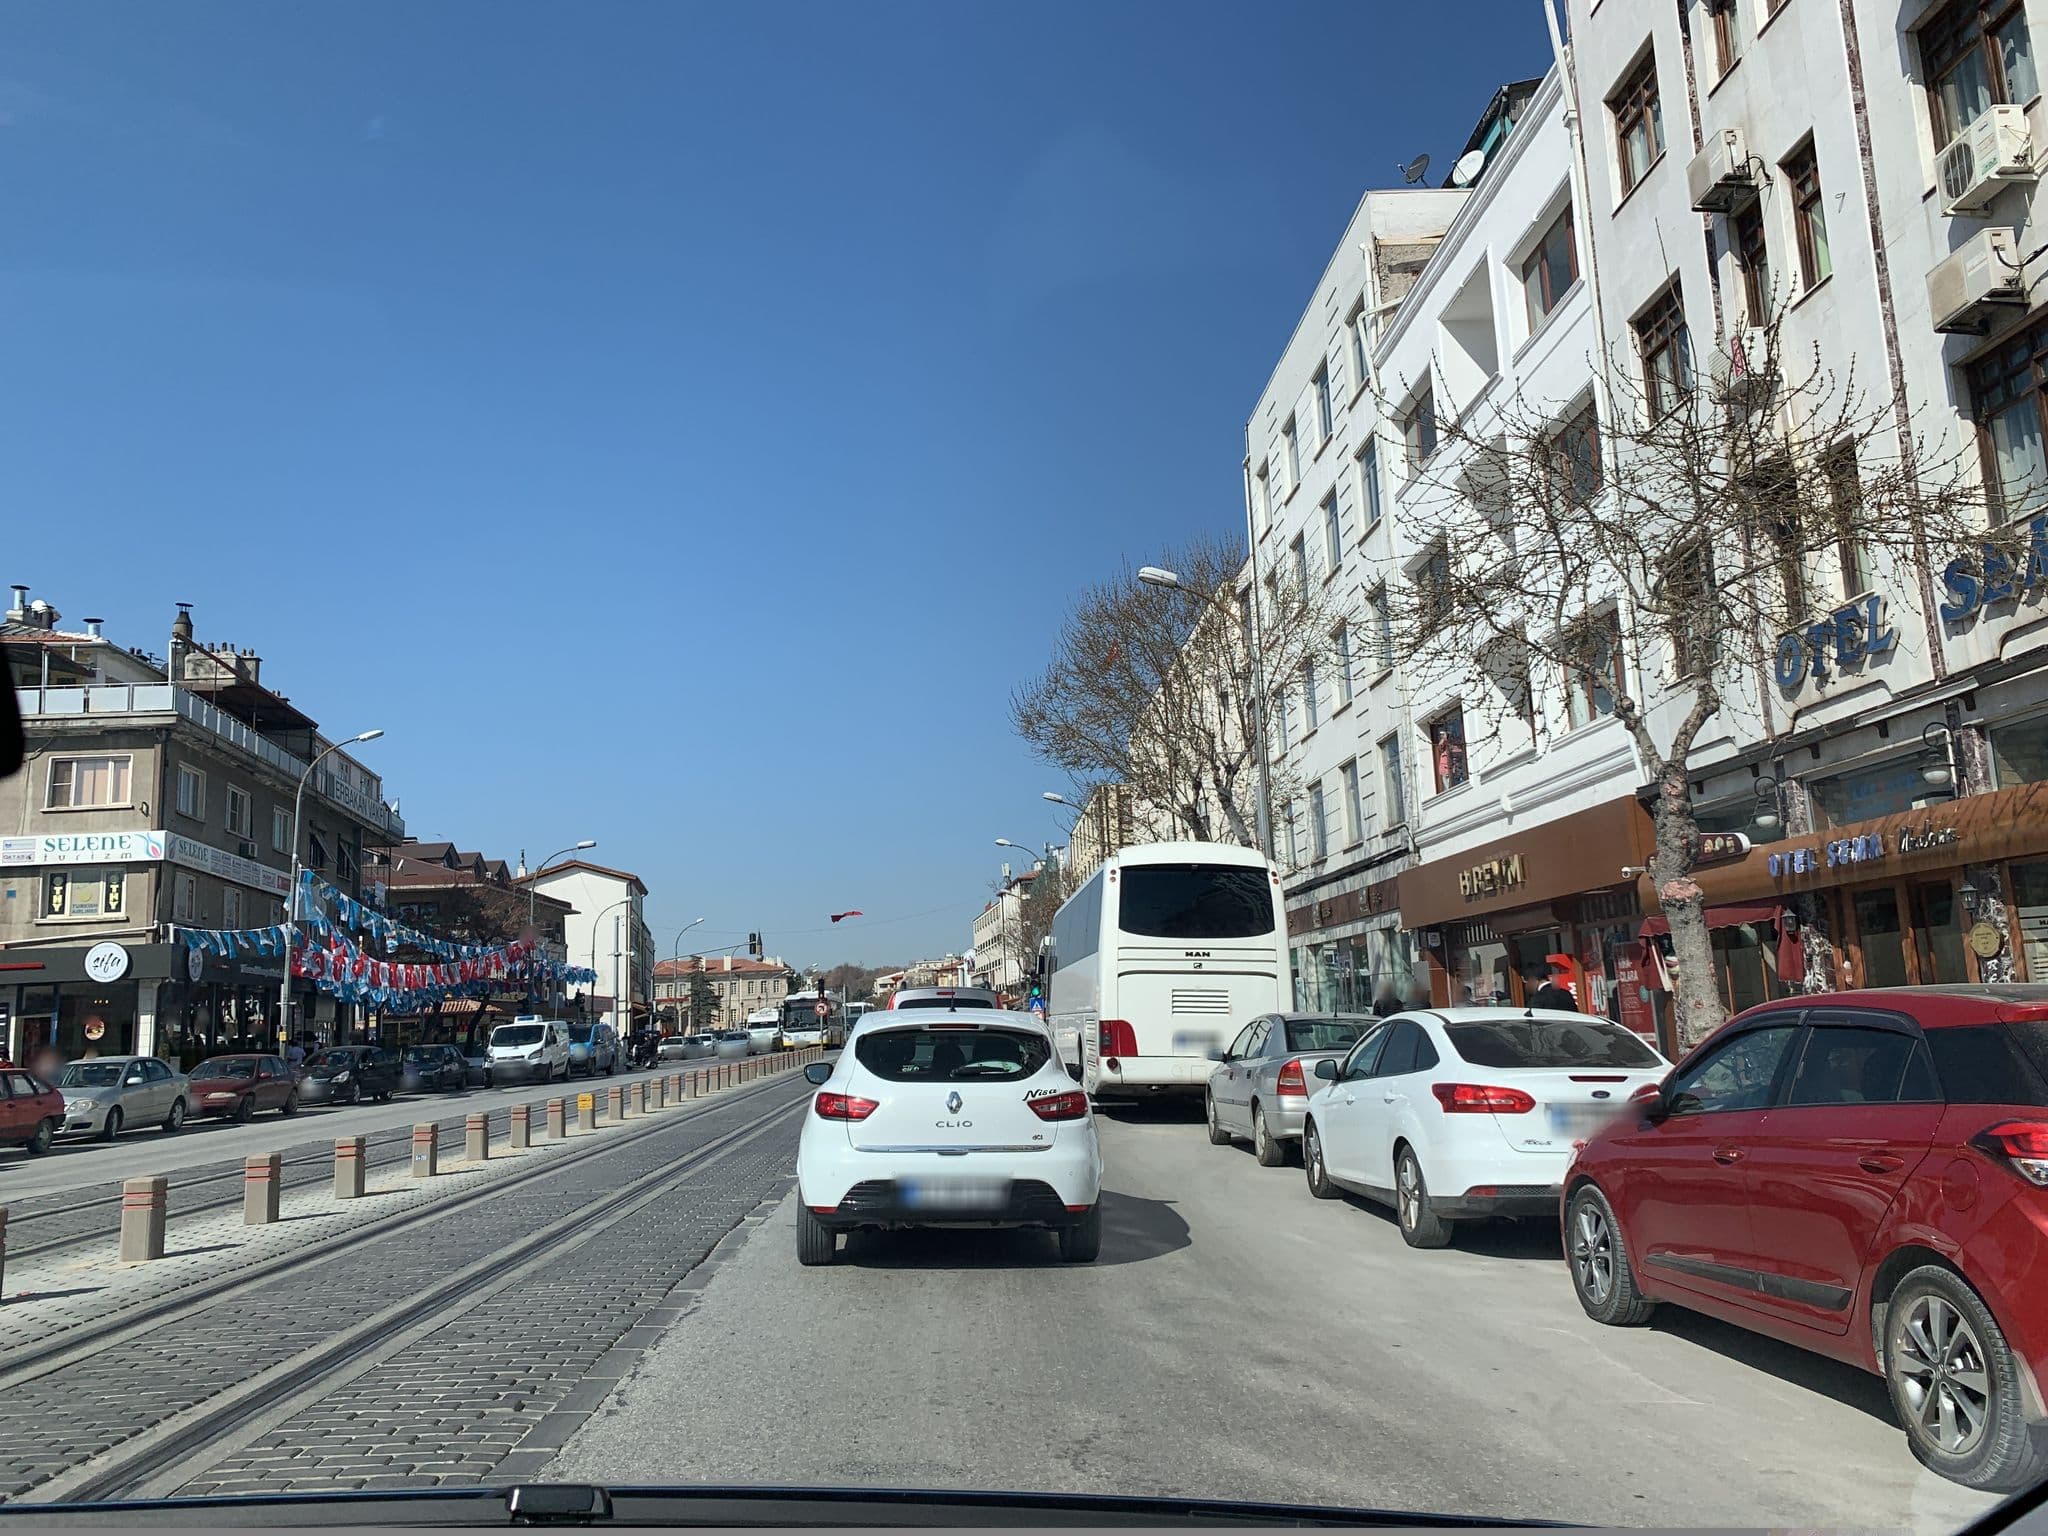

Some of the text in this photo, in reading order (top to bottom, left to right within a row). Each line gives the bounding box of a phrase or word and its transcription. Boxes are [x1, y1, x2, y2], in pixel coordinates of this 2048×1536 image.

[1774, 594, 1899, 688] OTEL
[1768, 847, 1818, 878] OTEL
[1827, 832, 1885, 868] SEMA
[1022, 1088, 1057, 1101] Nisa
